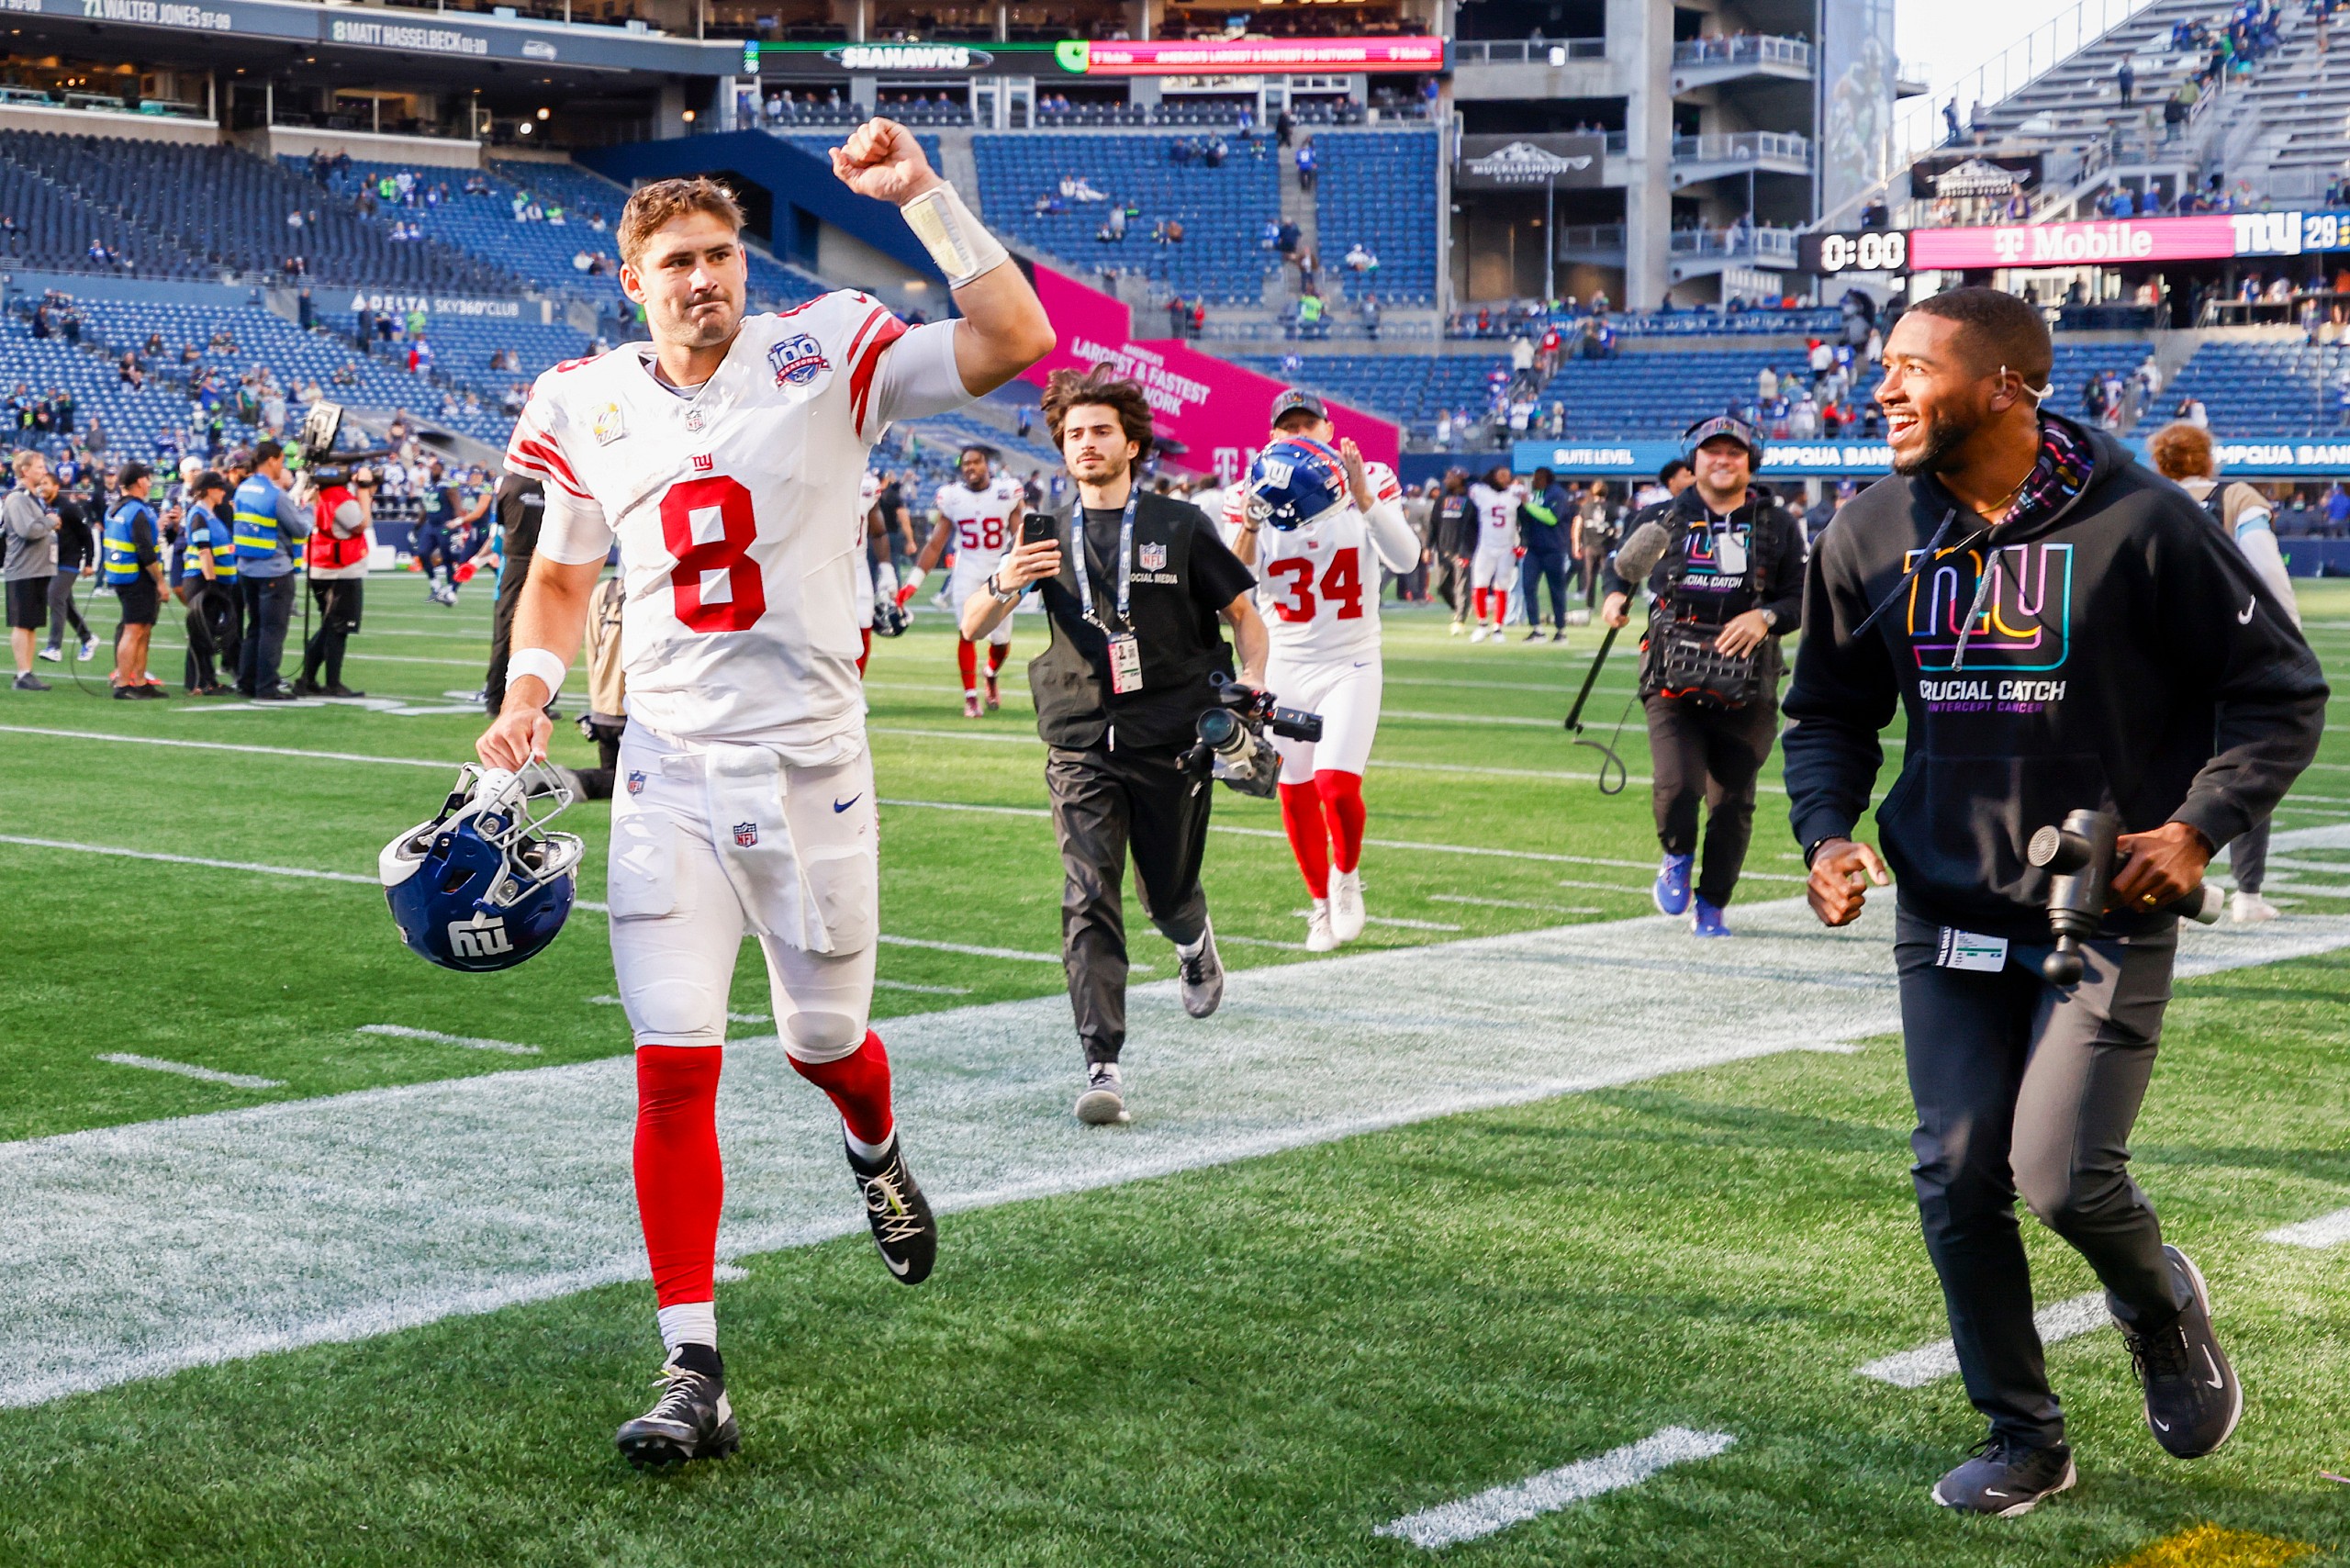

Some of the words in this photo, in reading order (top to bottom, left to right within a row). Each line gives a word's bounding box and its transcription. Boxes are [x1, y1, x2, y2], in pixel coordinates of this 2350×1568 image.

[105, 0, 158, 23] WALTER
[158, 4, 201, 28] JONES
[332, 20, 347, 42] 8
[346, 21, 384, 44] MATT
[382, 26, 462, 52] HASSELBECK
[841, 47, 971, 69] SEAHAWKS
[2031, 222, 2153, 262] Mobile
[2302, 215, 2338, 250] 29
[1821, 231, 1906, 271] 0:00
[369, 295, 430, 313] DELTA
[767, 336, 822, 375] 100
[778, 356, 821, 377] SEASONS
[1071, 336, 1136, 375] LARGEST
[1147, 364, 1212, 406] FASTEST
[1553, 448, 1593, 465] SUITE
[1593, 448, 1635, 465] LEVEL
[2212, 445, 2295, 465] MPQUA
[2297, 445, 2350, 465] BAN
[1491, 506, 1506, 528] 5
[957, 517, 1004, 550] 58
[660, 475, 767, 633] 8
[1130, 573, 1154, 583] OCIAL
[1154, 573, 1179, 585] MEDIA
[1267, 547, 1364, 622] 34
[1709, 576, 1744, 588] CATCH
[1998, 679, 2067, 701] CATCH
[1929, 702, 1993, 713] INTERCEPT
[1997, 701, 2043, 713] CANCER
